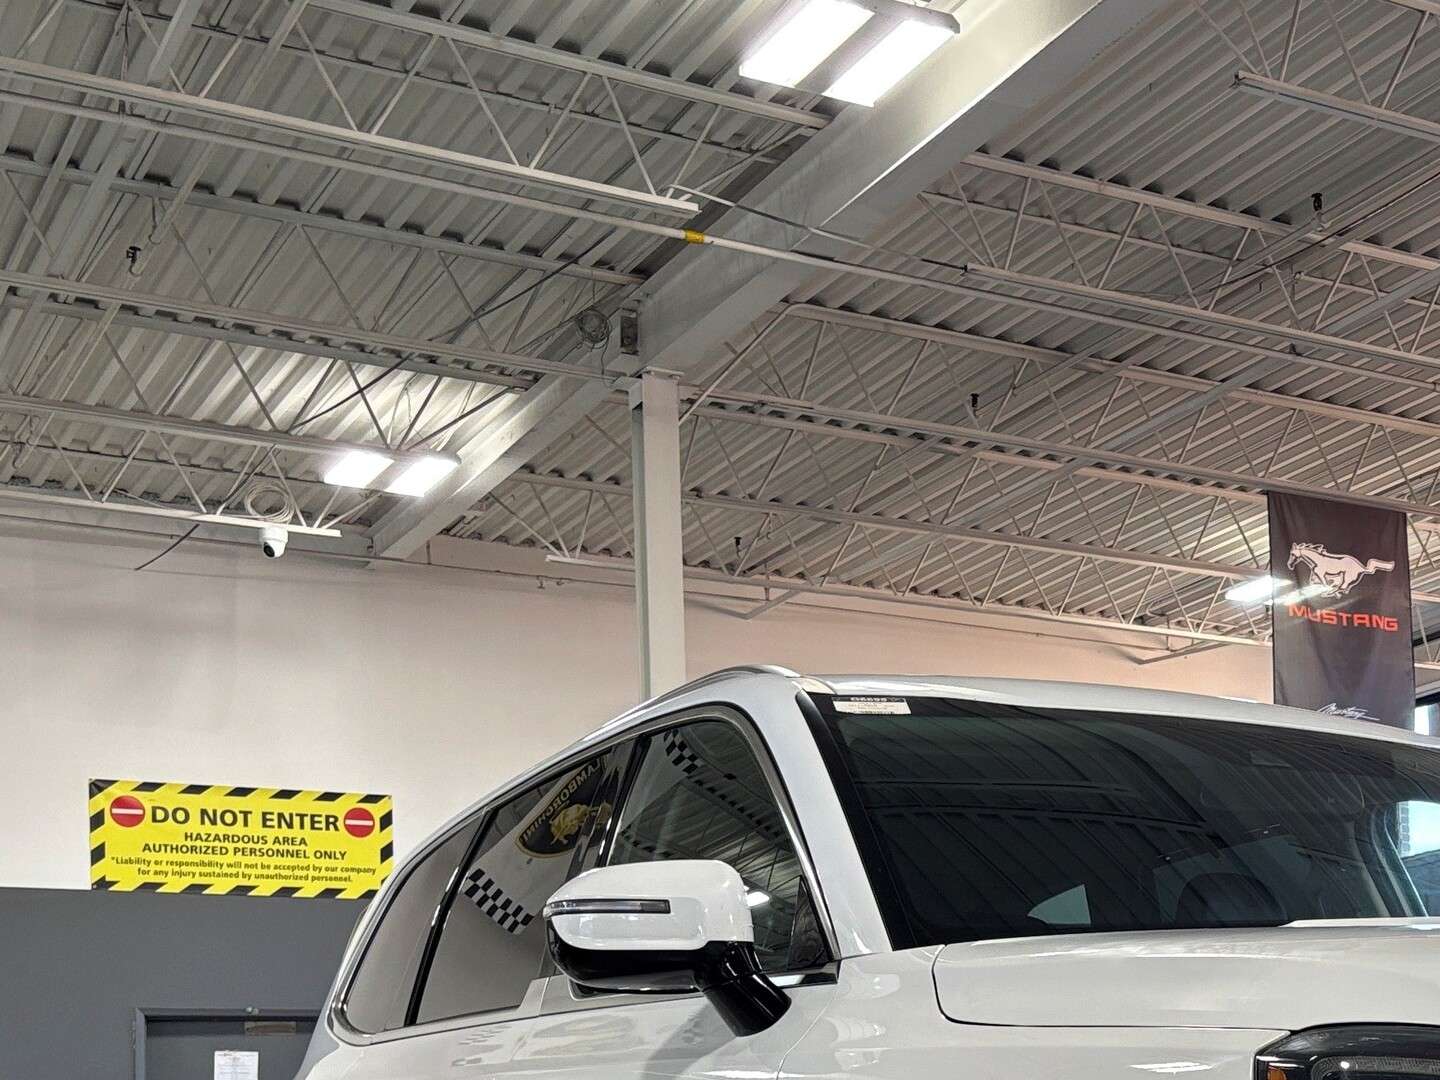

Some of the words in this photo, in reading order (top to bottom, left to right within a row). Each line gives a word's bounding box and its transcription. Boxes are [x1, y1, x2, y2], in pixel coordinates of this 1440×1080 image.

[1288, 602, 1399, 632] MUSTANG
[151, 806, 190, 825] DO
[200, 808, 253, 828] NOT
[261, 811, 340, 832] ENTER
[184, 832, 268, 845] HAZARDOUS
[272, 836, 308, 847] AREA
[142, 843, 229, 856] AUTHORIZED
[233, 846, 310, 859] PERSONNEL
[313, 850, 347, 860] ONLY
[137, 867, 151, 876] for
[153, 869, 168, 877] any
[171, 868, 196, 878] injury
[199, 869, 240, 878] sustained
[242, 871, 252, 880] by
[254, 872, 309, 881] unauthorized
[165, 859, 224, 869] responsibility
[244, 861, 258, 870] not
[261, 862, 271, 870] be
[273, 862, 310, 872] accepted
[312, 863, 323, 873] by
[340, 865, 377, 875] company
